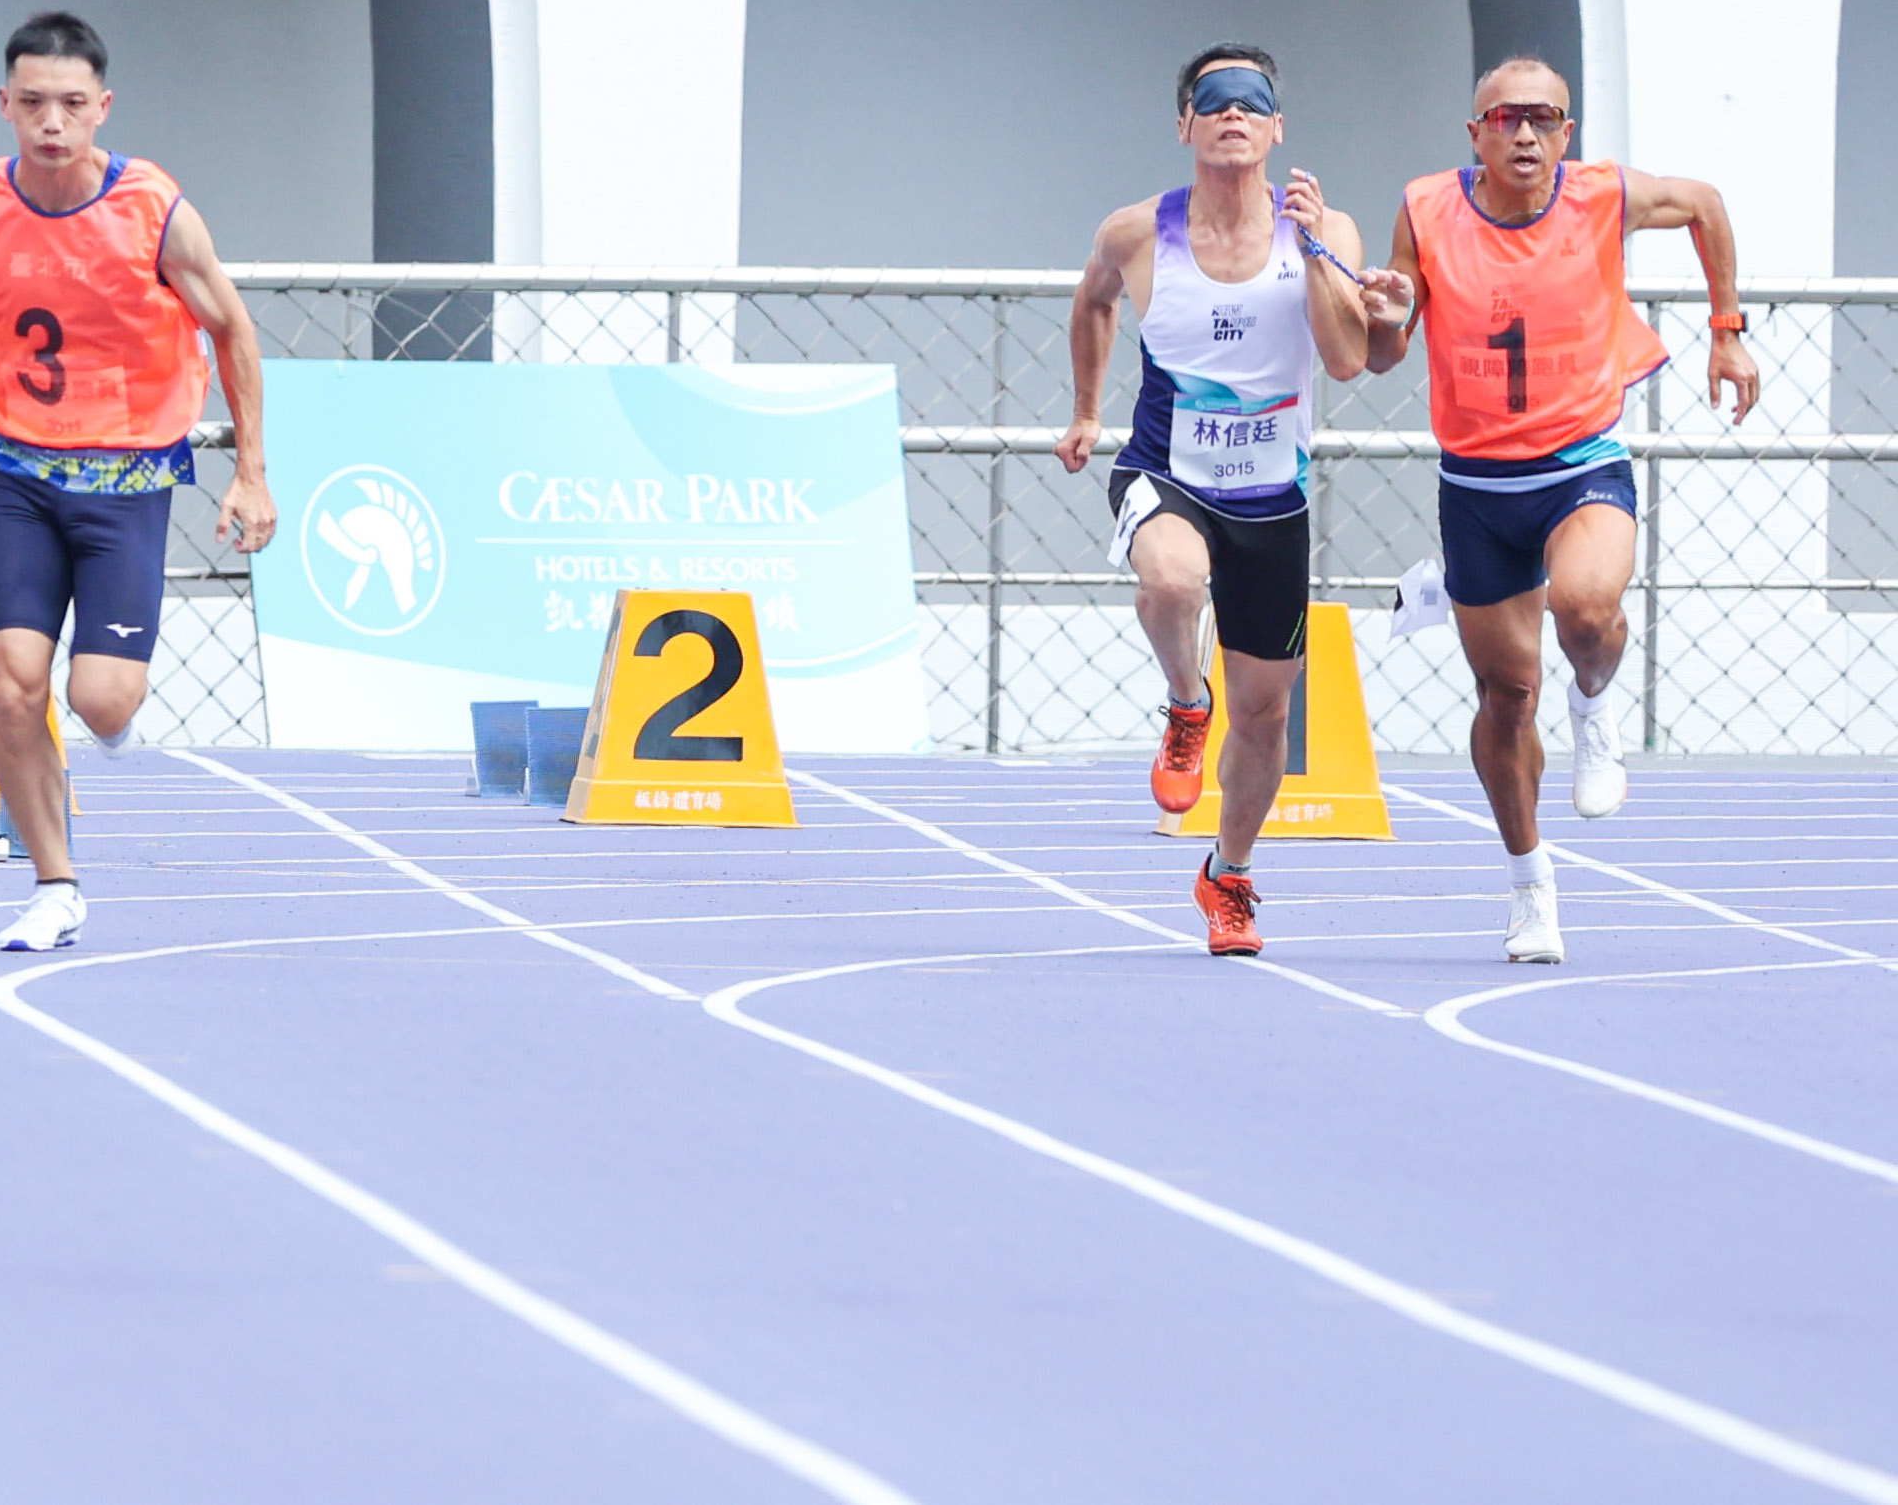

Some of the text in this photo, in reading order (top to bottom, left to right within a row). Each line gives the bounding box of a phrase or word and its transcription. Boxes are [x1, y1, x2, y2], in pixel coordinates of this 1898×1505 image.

[1213, 329, 1244, 341] CITY
[15, 307, 65, 406] 3
[1487, 317, 1526, 413] 1
[1193, 416, 1277, 448] 林信廷
[1214, 461, 1254, 478] 3015
[685, 473, 820, 524] PARK
[536, 556, 799, 582] HOTELS & RESORTS
[633, 609, 744, 762] 2
